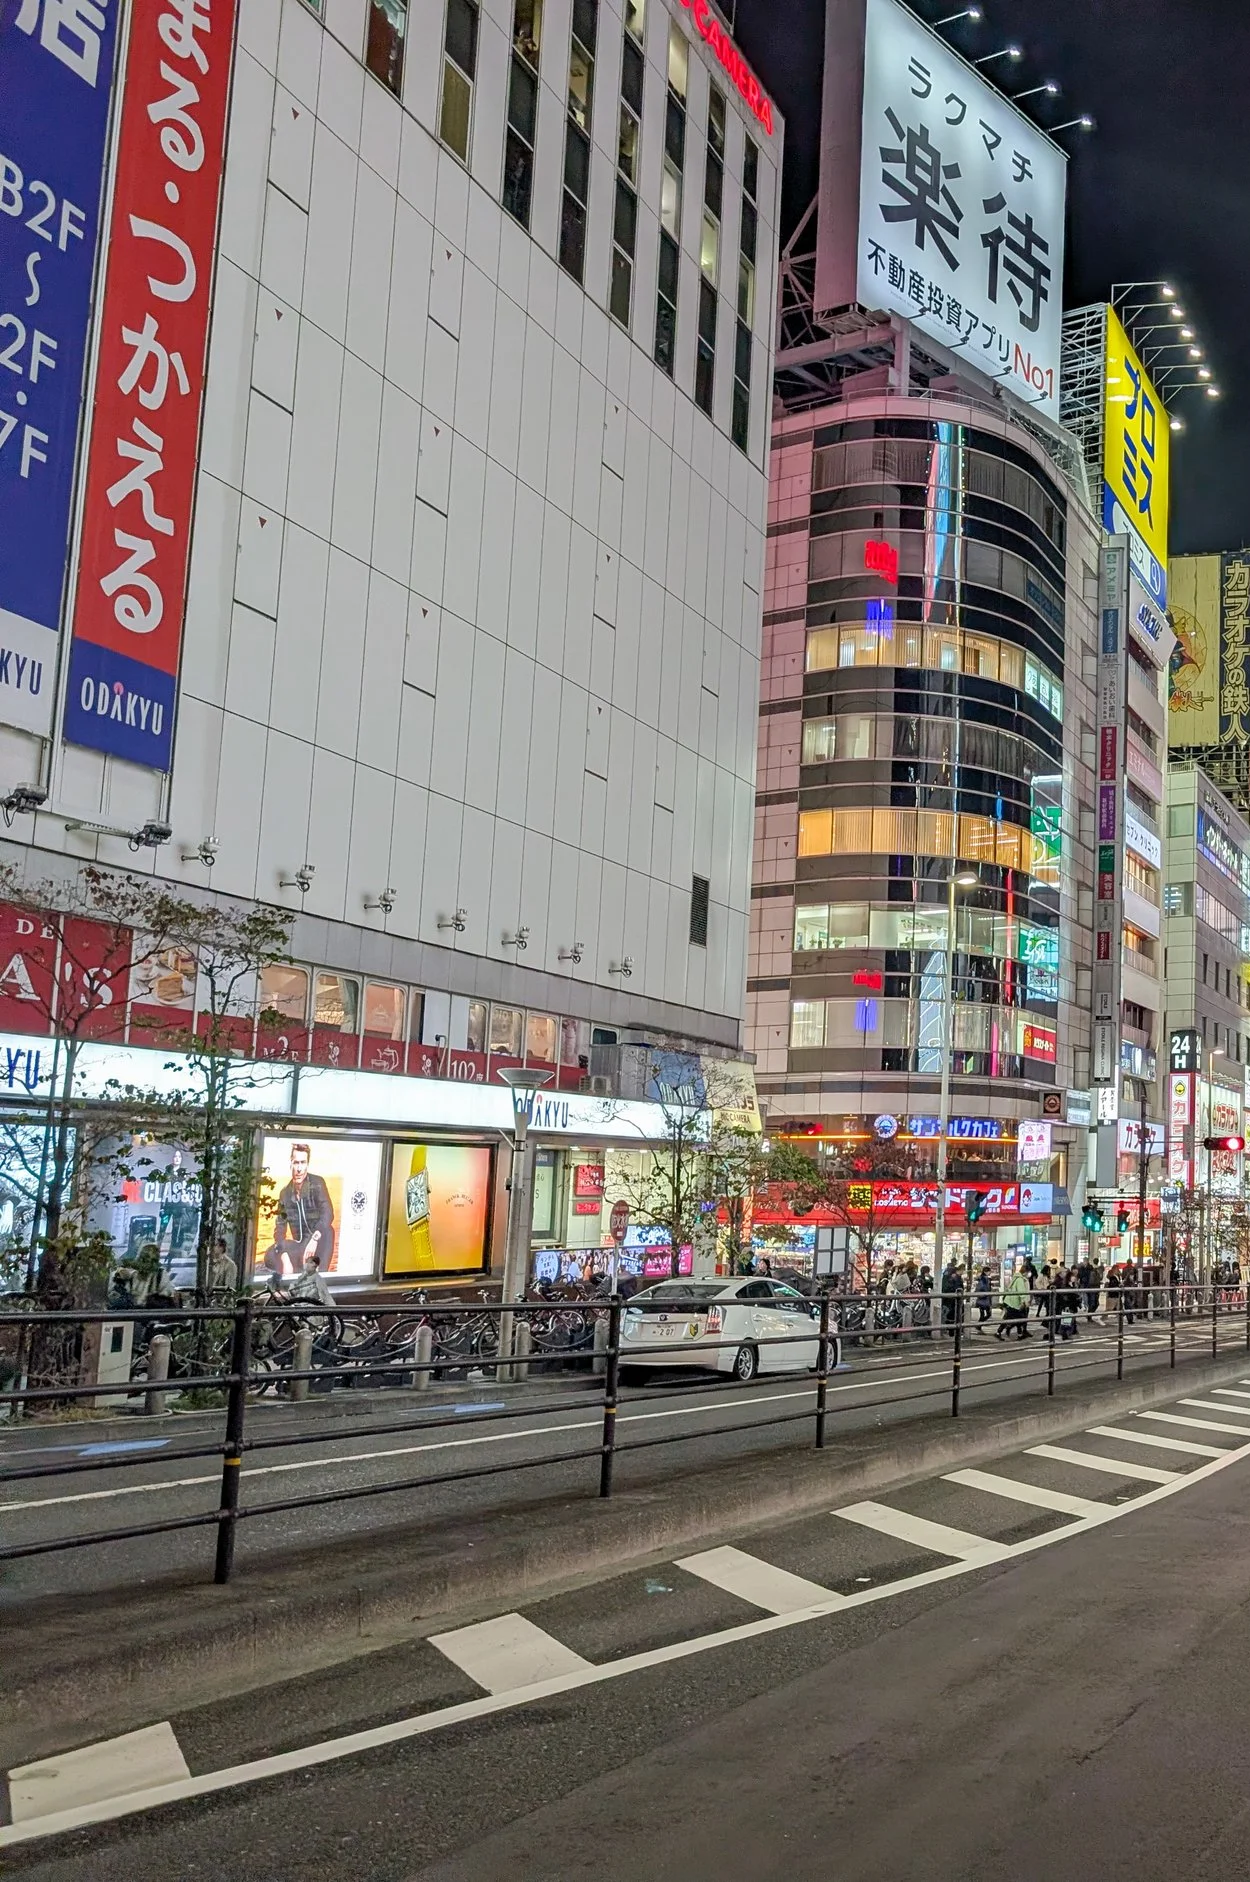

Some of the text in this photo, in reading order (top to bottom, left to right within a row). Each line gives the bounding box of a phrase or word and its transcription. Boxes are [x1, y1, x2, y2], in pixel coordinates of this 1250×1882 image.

[693, 0, 773, 135] CAMERA
[906, 56, 1034, 184] ラクマチ
[878, 106, 1052, 334] 楽待
[80, 676, 164, 736] ODAKYU
[16, 918, 55, 940] DE
[1171, 1035, 1190, 1054] 24
[1174, 1055, 1187, 1069] H
[909, 1118, 999, 1138] サンルクカフェ
[909, 1187, 1003, 1209] サンドグ
